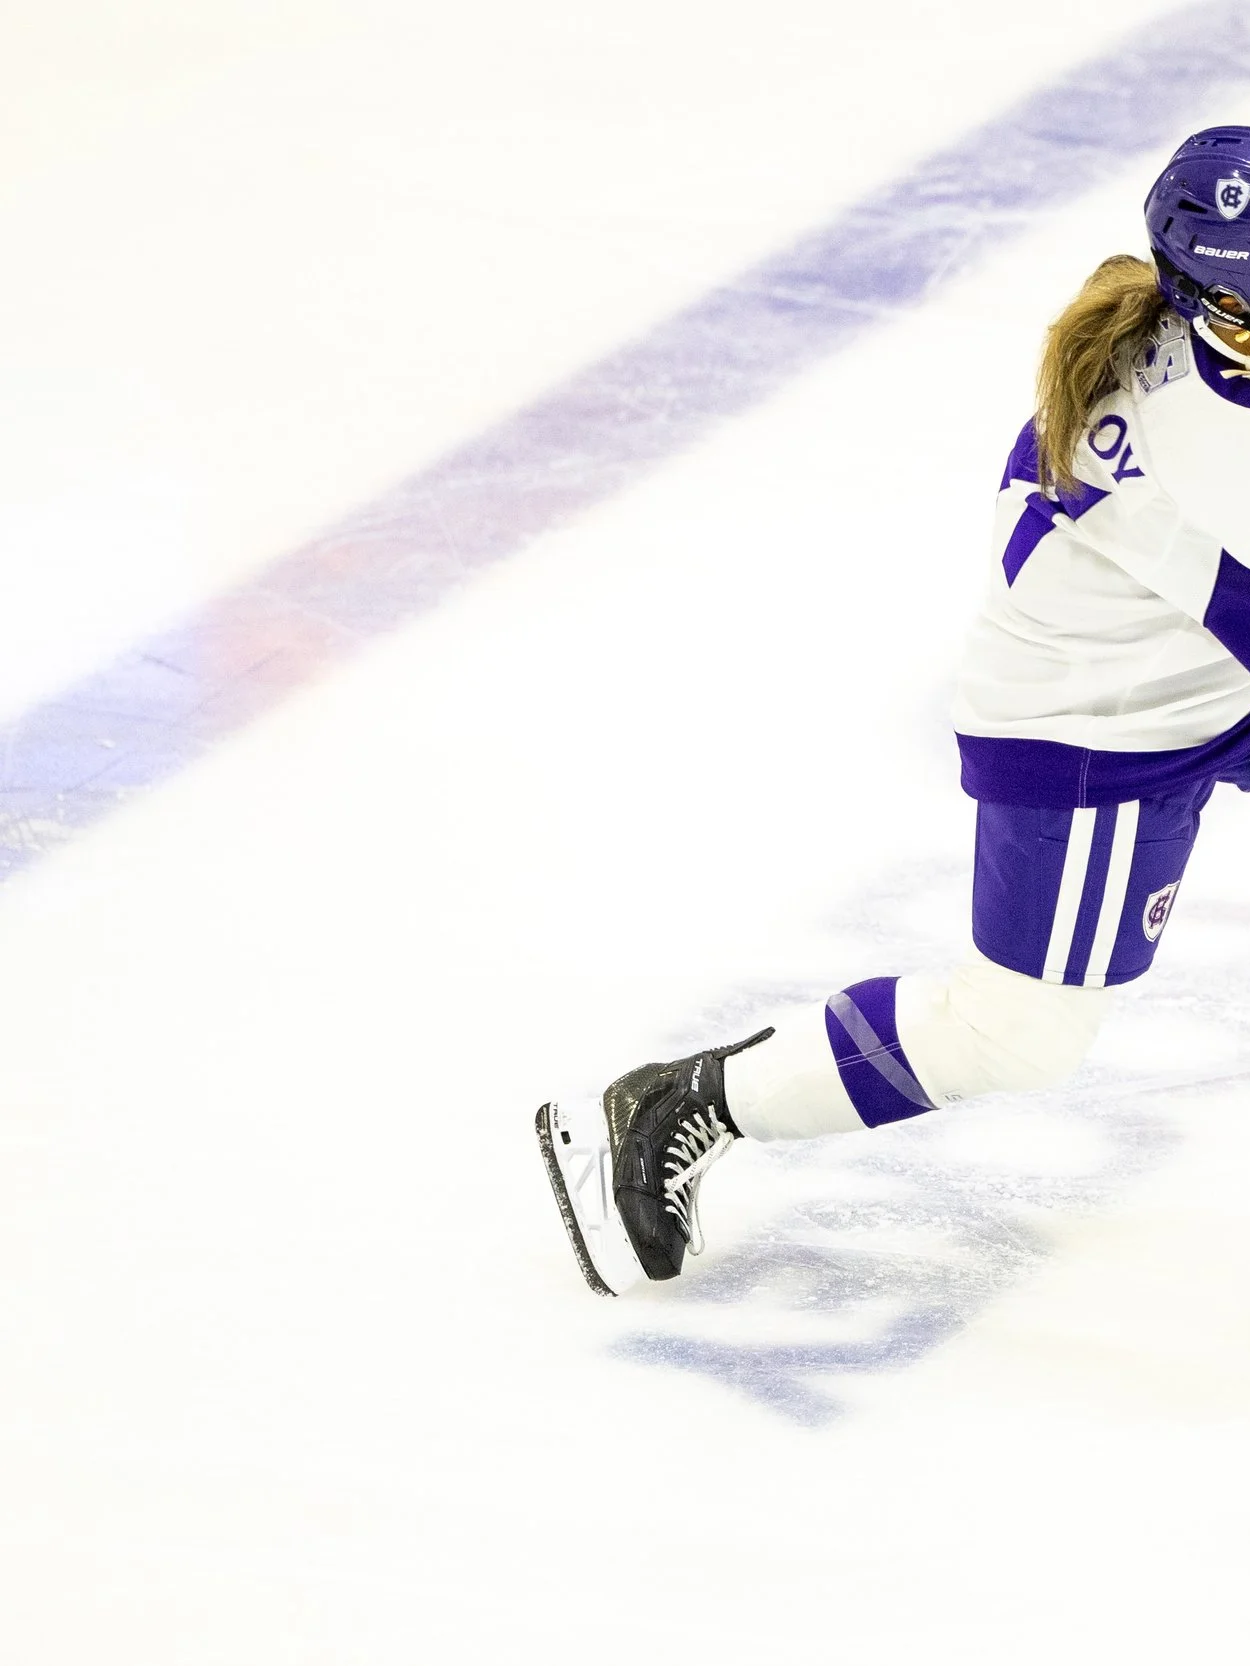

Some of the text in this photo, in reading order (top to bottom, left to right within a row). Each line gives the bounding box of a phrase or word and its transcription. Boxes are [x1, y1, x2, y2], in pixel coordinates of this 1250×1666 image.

[1193, 244, 1250, 261] BAUER
[1200, 297, 1245, 326] BAUER
[1088, 414, 1146, 484] OY
[691, 1058, 703, 1093] TRUE
